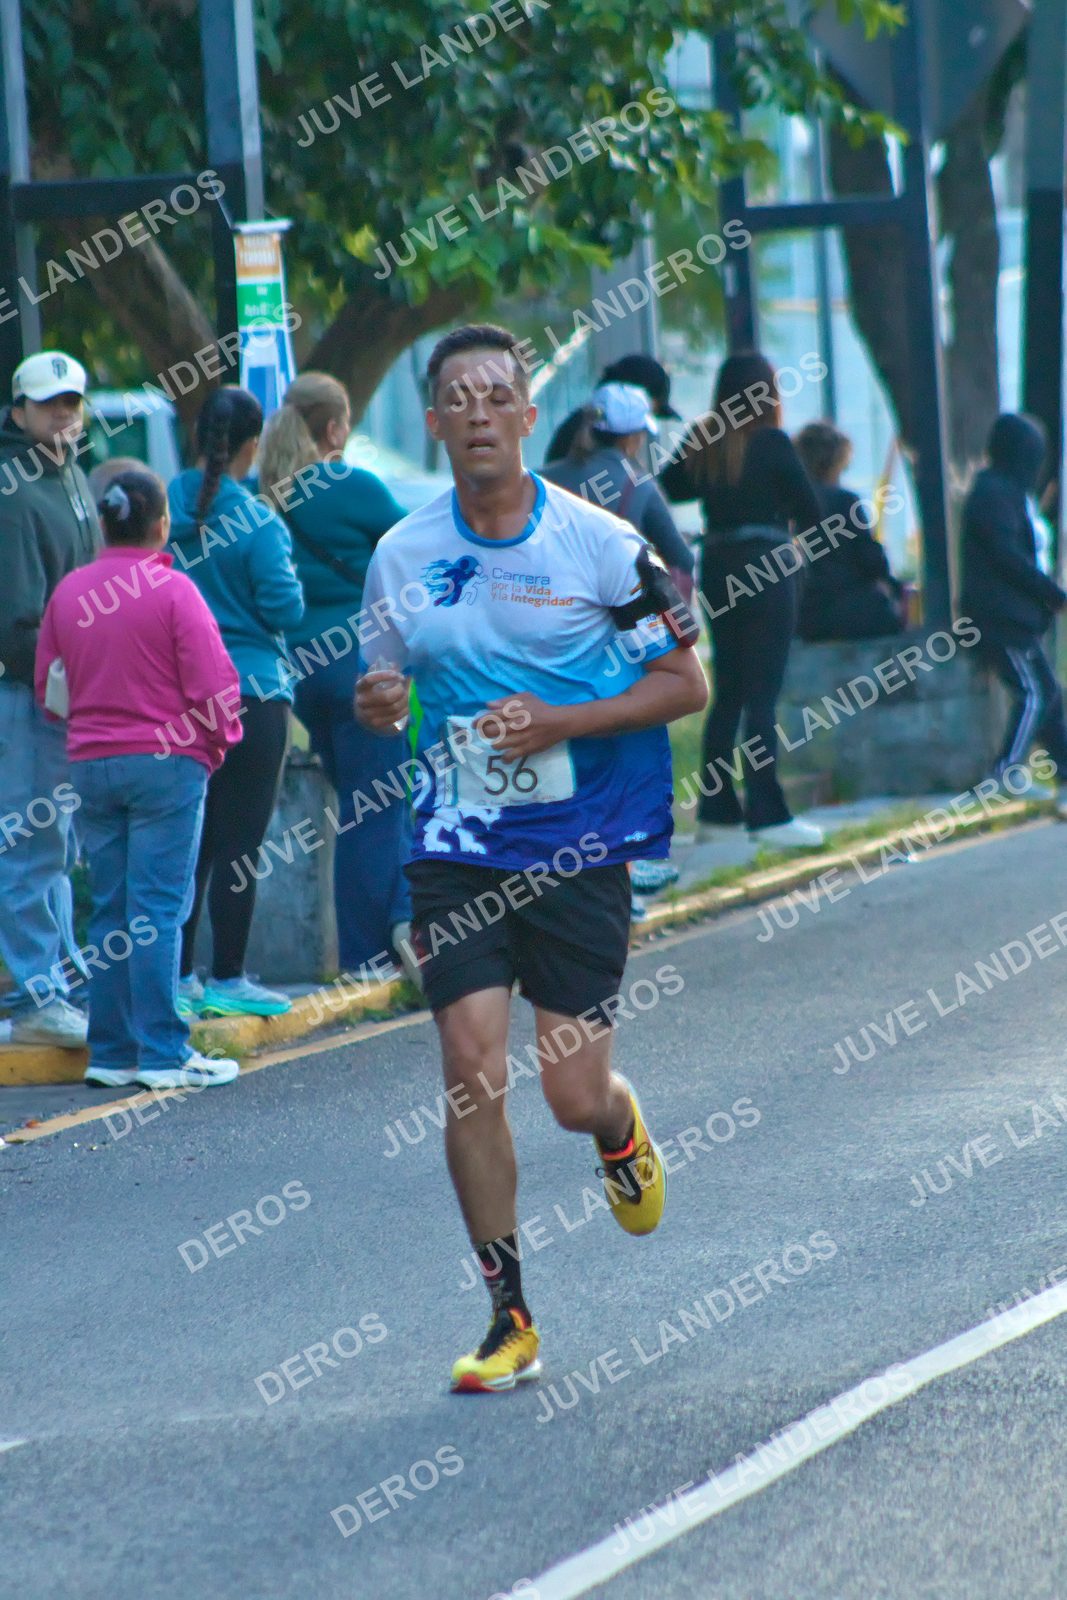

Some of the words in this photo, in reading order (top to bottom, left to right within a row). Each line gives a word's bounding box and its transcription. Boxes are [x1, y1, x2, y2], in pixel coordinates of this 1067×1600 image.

[492, 567, 550, 585] Carrera
[491, 582, 508, 590] por
[525, 585, 551, 595] Vida
[511, 592, 574, 607] Integridad
[484, 755, 538, 796] 56
